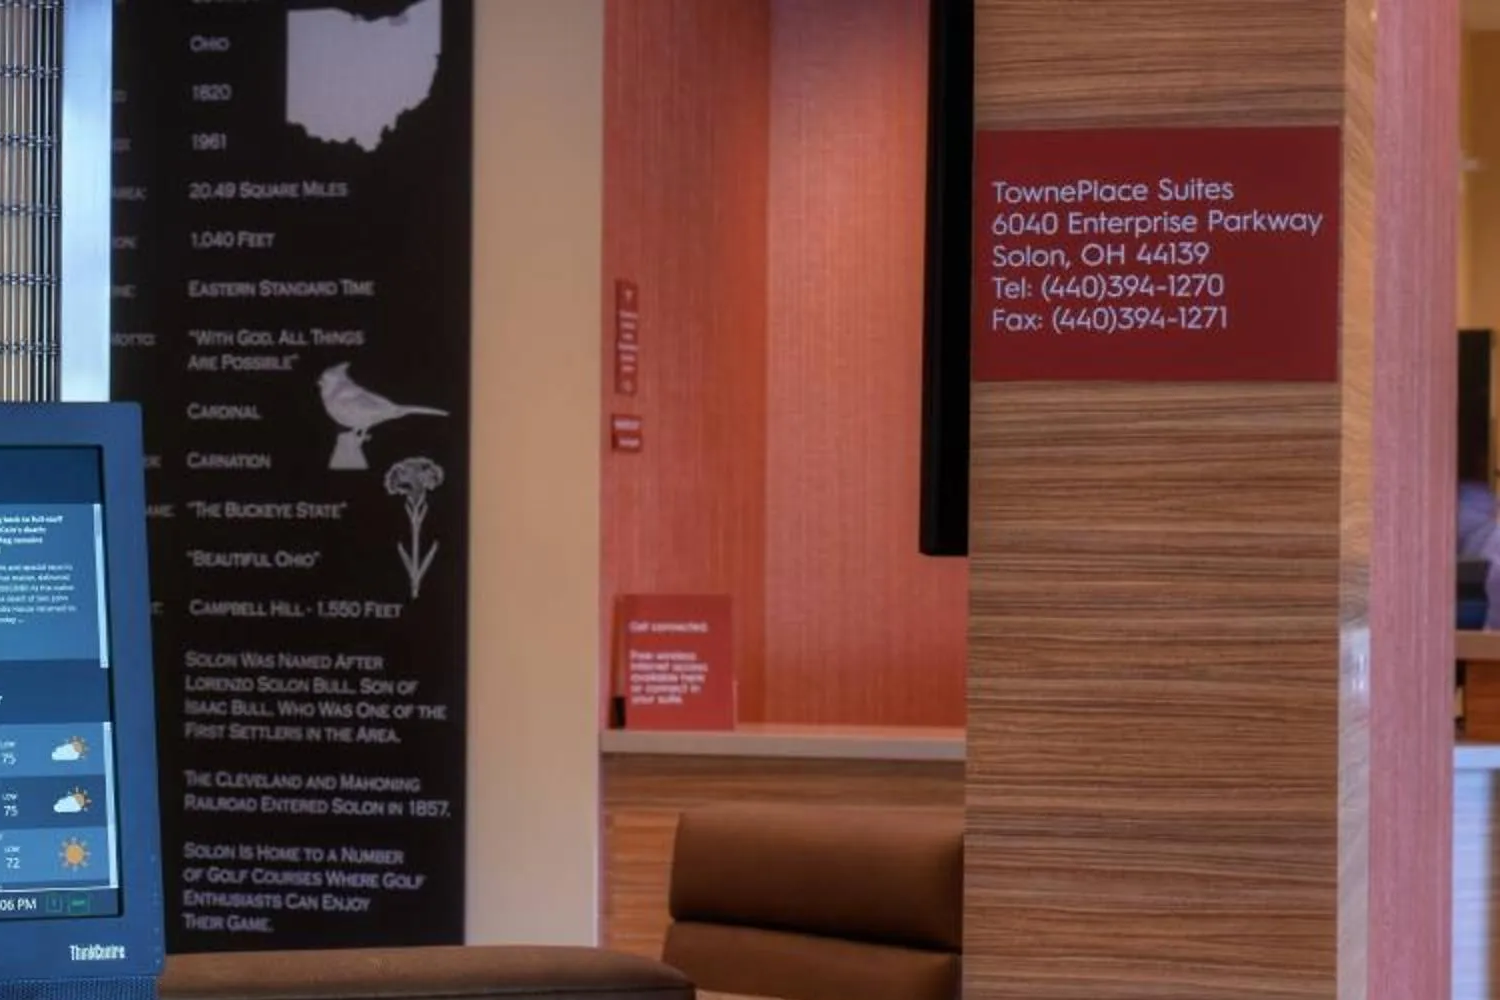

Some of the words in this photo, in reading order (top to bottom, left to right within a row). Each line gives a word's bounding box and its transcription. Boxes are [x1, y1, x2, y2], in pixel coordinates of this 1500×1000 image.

[192, 133, 227, 150] 1961
[188, 181, 237, 199] 20.49
[991, 179, 1148, 203] TownePlace
[1157, 178, 1235, 201] Suites
[991, 212, 1058, 236] 6040
[1067, 210, 1197, 238] Enterprise
[1207, 208, 1323, 236] Parkway
[991, 245, 1071, 270] Solon,
[1080, 243, 1126, 266] OH
[1136, 241, 1210, 266] 44139
[991, 276, 1033, 300] Tel:
[1041, 272, 1225, 302] (440)394-1270
[991, 308, 1043, 332] Fax:
[1052, 305, 1228, 334] (440)394-1271
[2, 751, 17, 765] 75
[6, 857, 21, 869] 72
[17, 898, 37, 910] PM
